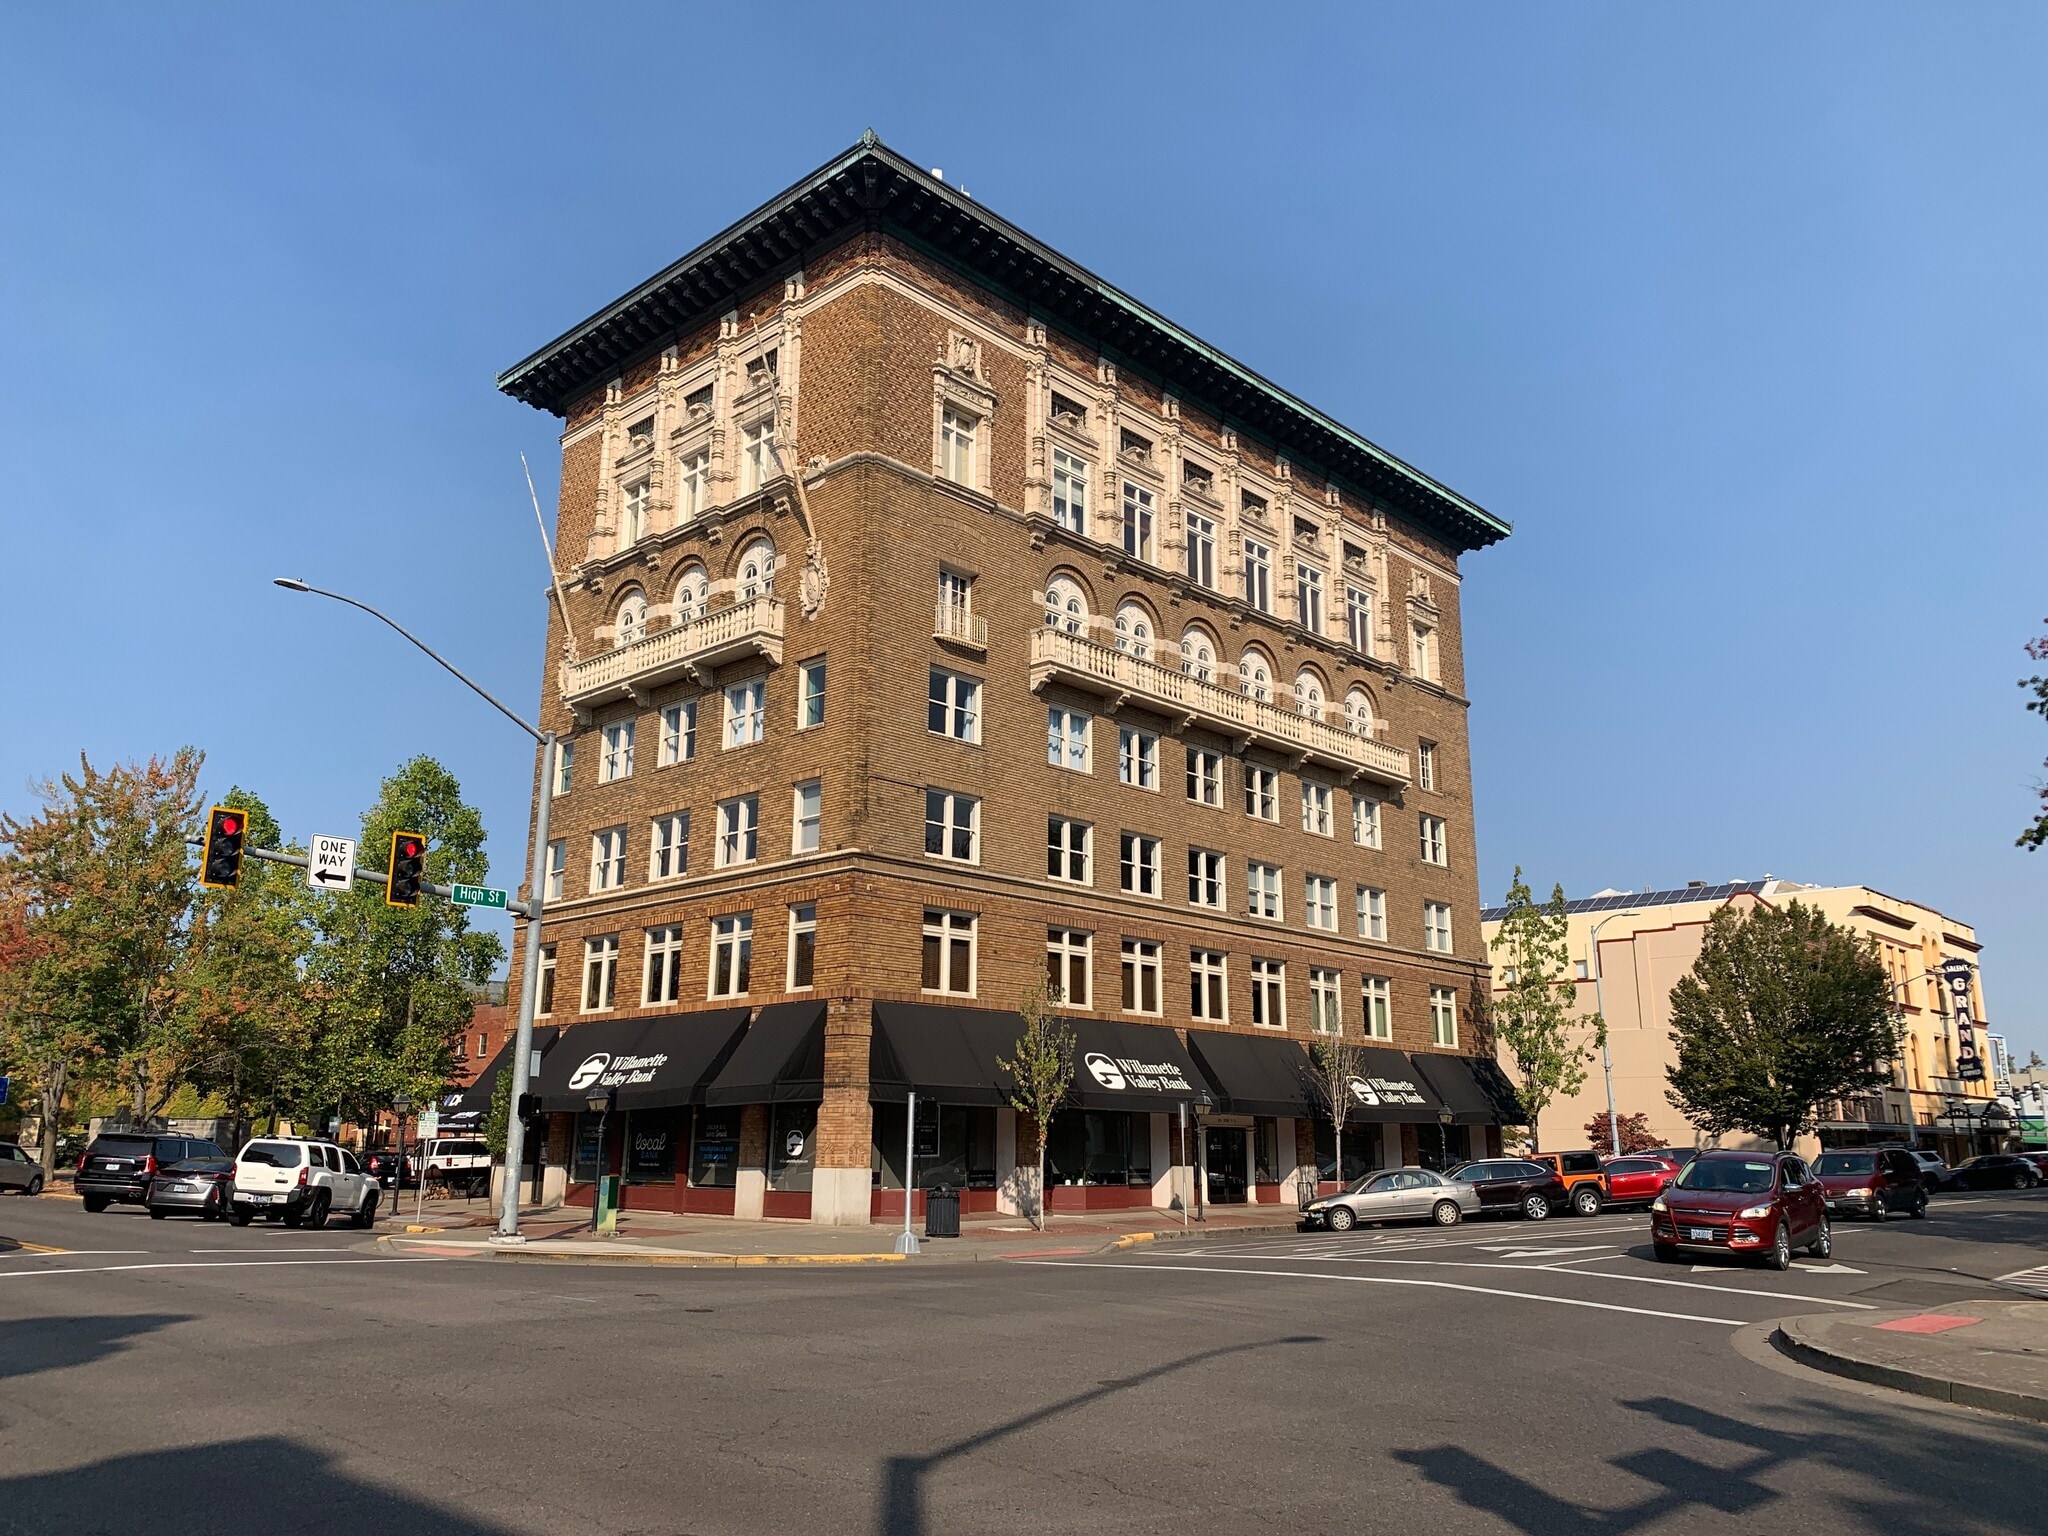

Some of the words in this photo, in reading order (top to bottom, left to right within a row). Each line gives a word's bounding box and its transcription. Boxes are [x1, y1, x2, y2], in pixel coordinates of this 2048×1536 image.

[320, 840, 347, 854] ONE
[318, 853, 347, 867] WAY
[460, 887, 483, 904] High
[488, 889, 500, 903] St
[1952, 977, 1974, 1060] GRAND
[610, 1053, 668, 1071] Willamette
[1115, 1058, 1182, 1076] Willamette
[600, 1072, 630, 1088] Valley
[626, 1068, 656, 1084] Bank
[1125, 1074, 1162, 1092] Valley
[1159, 1076, 1192, 1090] Bank
[1367, 1078, 1416, 1091] Willamette
[1377, 1091, 1406, 1106] Valley
[1401, 1092, 1426, 1104] Bank
[635, 1133, 667, 1151] local
[641, 1151, 659, 1159] BANK
